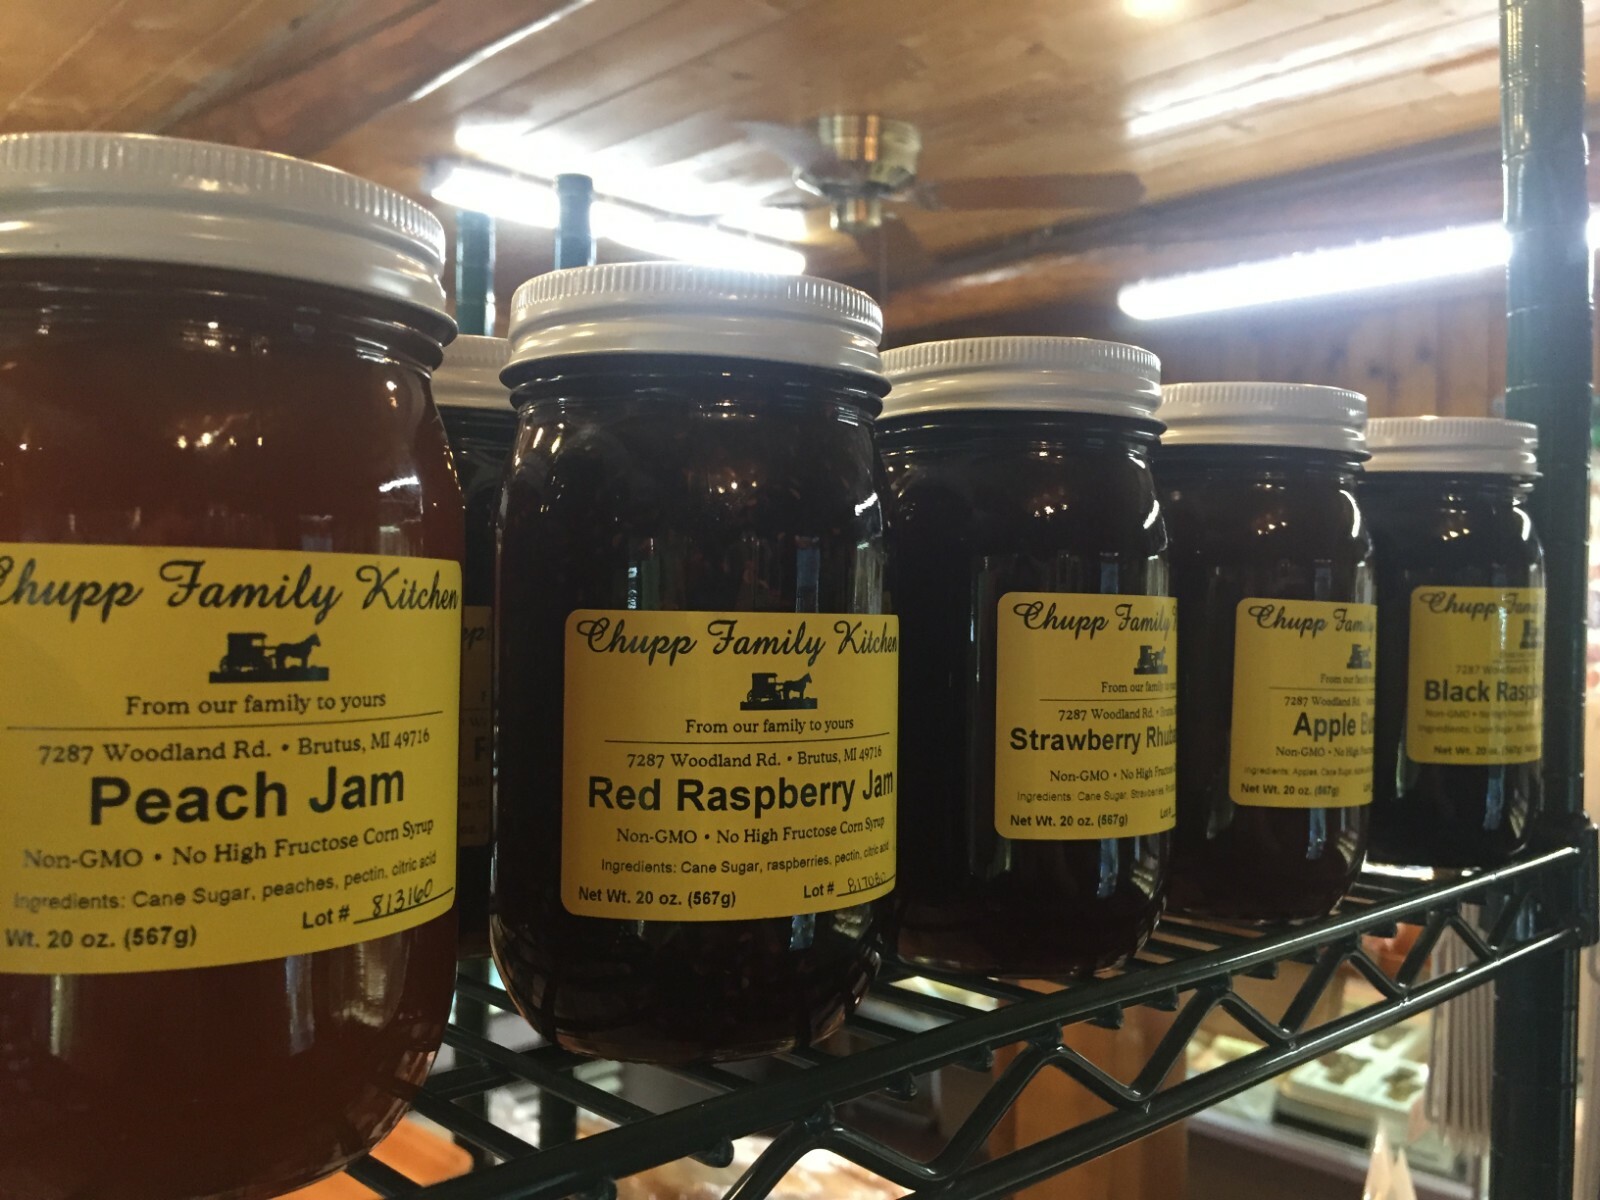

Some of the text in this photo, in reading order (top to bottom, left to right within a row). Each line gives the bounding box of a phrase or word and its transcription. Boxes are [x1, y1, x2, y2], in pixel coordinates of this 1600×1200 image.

[159, 560, 342, 625] Family
[356, 565, 458, 610] Kitchen
[1418, 591, 1500, 622] Chupp
[1013, 601, 1109, 640] Chupp
[1114, 603, 1170, 641] Family
[1248, 604, 1327, 638] Chupp
[577, 617, 897, 667] Chupp Family Kitchen
[1101, 681, 1128, 693] From
[1130, 684, 1144, 692] our
[1424, 679, 1489, 702] Black
[126, 693, 386, 715] From our family to yours
[1058, 709, 1087, 721] 7287
[1091, 708, 1140, 719] Woodland
[686, 718, 854, 734] From our family to yours
[1293, 712, 1356, 742] Apple
[39, 728, 430, 765] 7287 Woodland Rd. Brutus, MI 49716
[1010, 727, 1141, 755] Strawberry
[627, 746, 882, 769] 7287 Woodland Rd. Brutus, MI 49716
[1050, 770, 1109, 782] Non-GMO
[1121, 769, 1134, 780] No
[1136, 768, 1153, 780] High
[91, 766, 404, 825] Peach Jam
[589, 769, 893, 819] Red Raspberry Jam
[1078, 791, 1101, 801] Cane
[617, 817, 884, 845] Non-GMO No High Fructose Corn Syrup
[1011, 815, 1031, 826] Net
[1060, 815, 1074, 827] 20
[1098, 814, 1128, 827] (567g)
[25, 819, 433, 869] Non-GMO No High Fructose Corn Syrup
[602, 859, 676, 874] Ingredients:
[681, 861, 717, 873] Cane
[721, 861, 762, 875] Sugar,
[132, 891, 186, 908] Cane
[195, 887, 255, 906] Sugar,
[262, 877, 338, 901] peaches,
[392, 858, 418, 877] citric
[419, 852, 437, 870] acid
[804, 884, 824, 898] Lot
[827, 882, 834, 893] #
[579, 886, 736, 908] Net Wt. 20 oz. (567g)
[302, 909, 333, 929] Lot
[339, 905, 350, 921] #
[5, 925, 197, 950] Wt. 20 oz. (567g)
